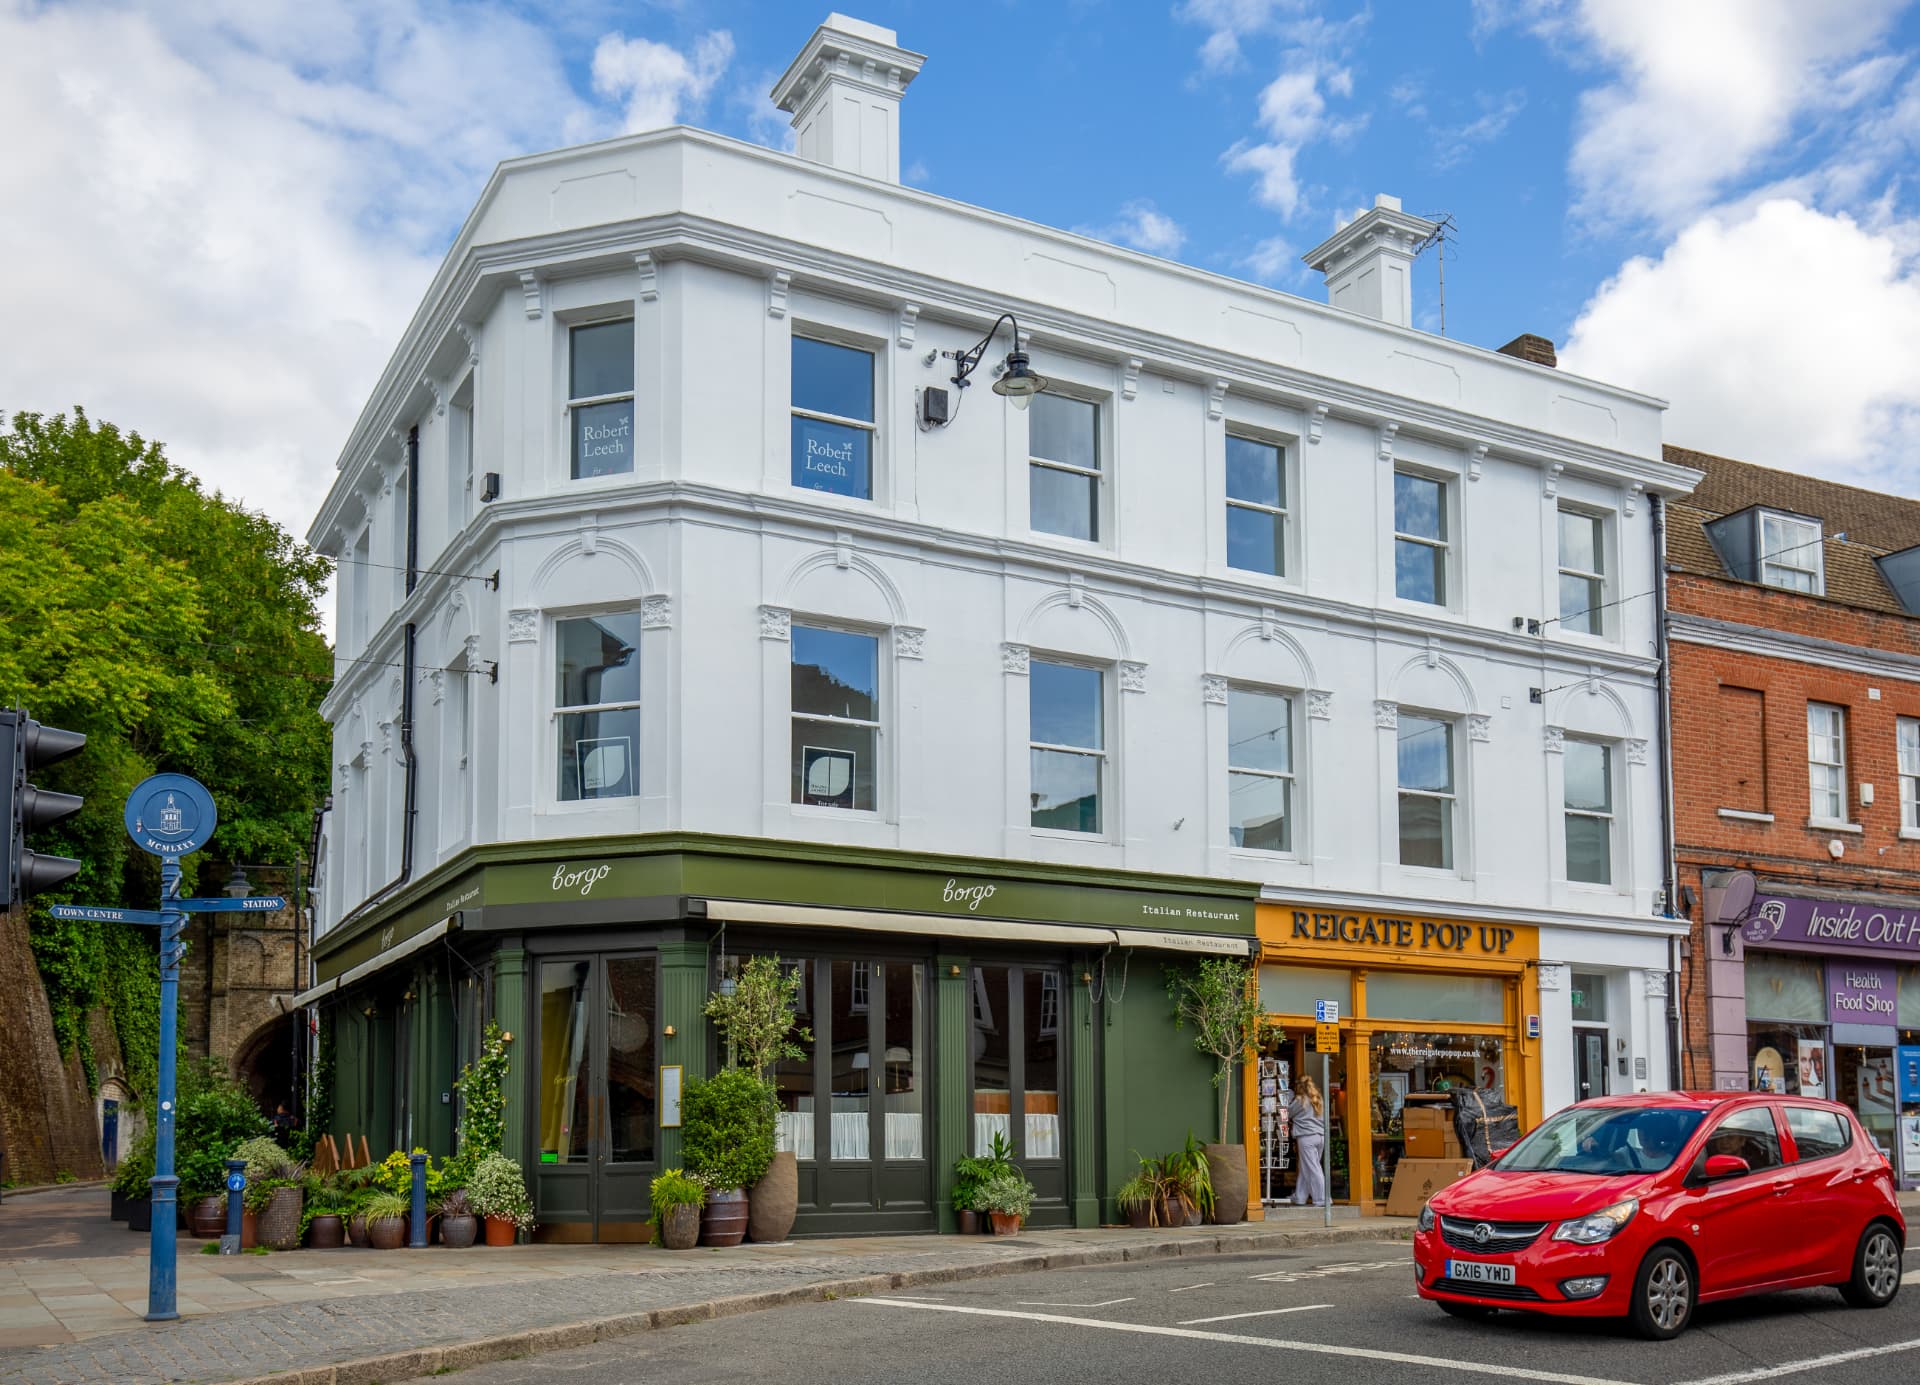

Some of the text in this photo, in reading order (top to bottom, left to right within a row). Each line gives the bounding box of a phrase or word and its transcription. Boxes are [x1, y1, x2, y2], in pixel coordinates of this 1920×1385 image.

[584, 424, 629, 441] Robert
[584, 440, 624, 457] Leech
[807, 438, 853, 461] Robert
[806, 461, 845, 477] Leech
[146, 839, 196, 852] MCMLXXX
[552, 864, 612, 895] borgo
[943, 878, 997, 910] borgo
[242, 899, 278, 908] STATION
[58, 907, 123, 919] TOWN CENTRE
[1142, 905, 1240, 920] Italian Restaurant
[1292, 911, 1514, 953] REIGATE POP UP
[1807, 906, 1862, 940] Inside
[1864, 913, 1906, 943] Out
[1845, 971, 1882, 990] Health
[1835, 992, 1894, 1016] Food Shop
[1390, 1047, 1480, 1059] www.thereigatepopup.co.uk
[1455, 1263, 1510, 1281] GX16 YWD
